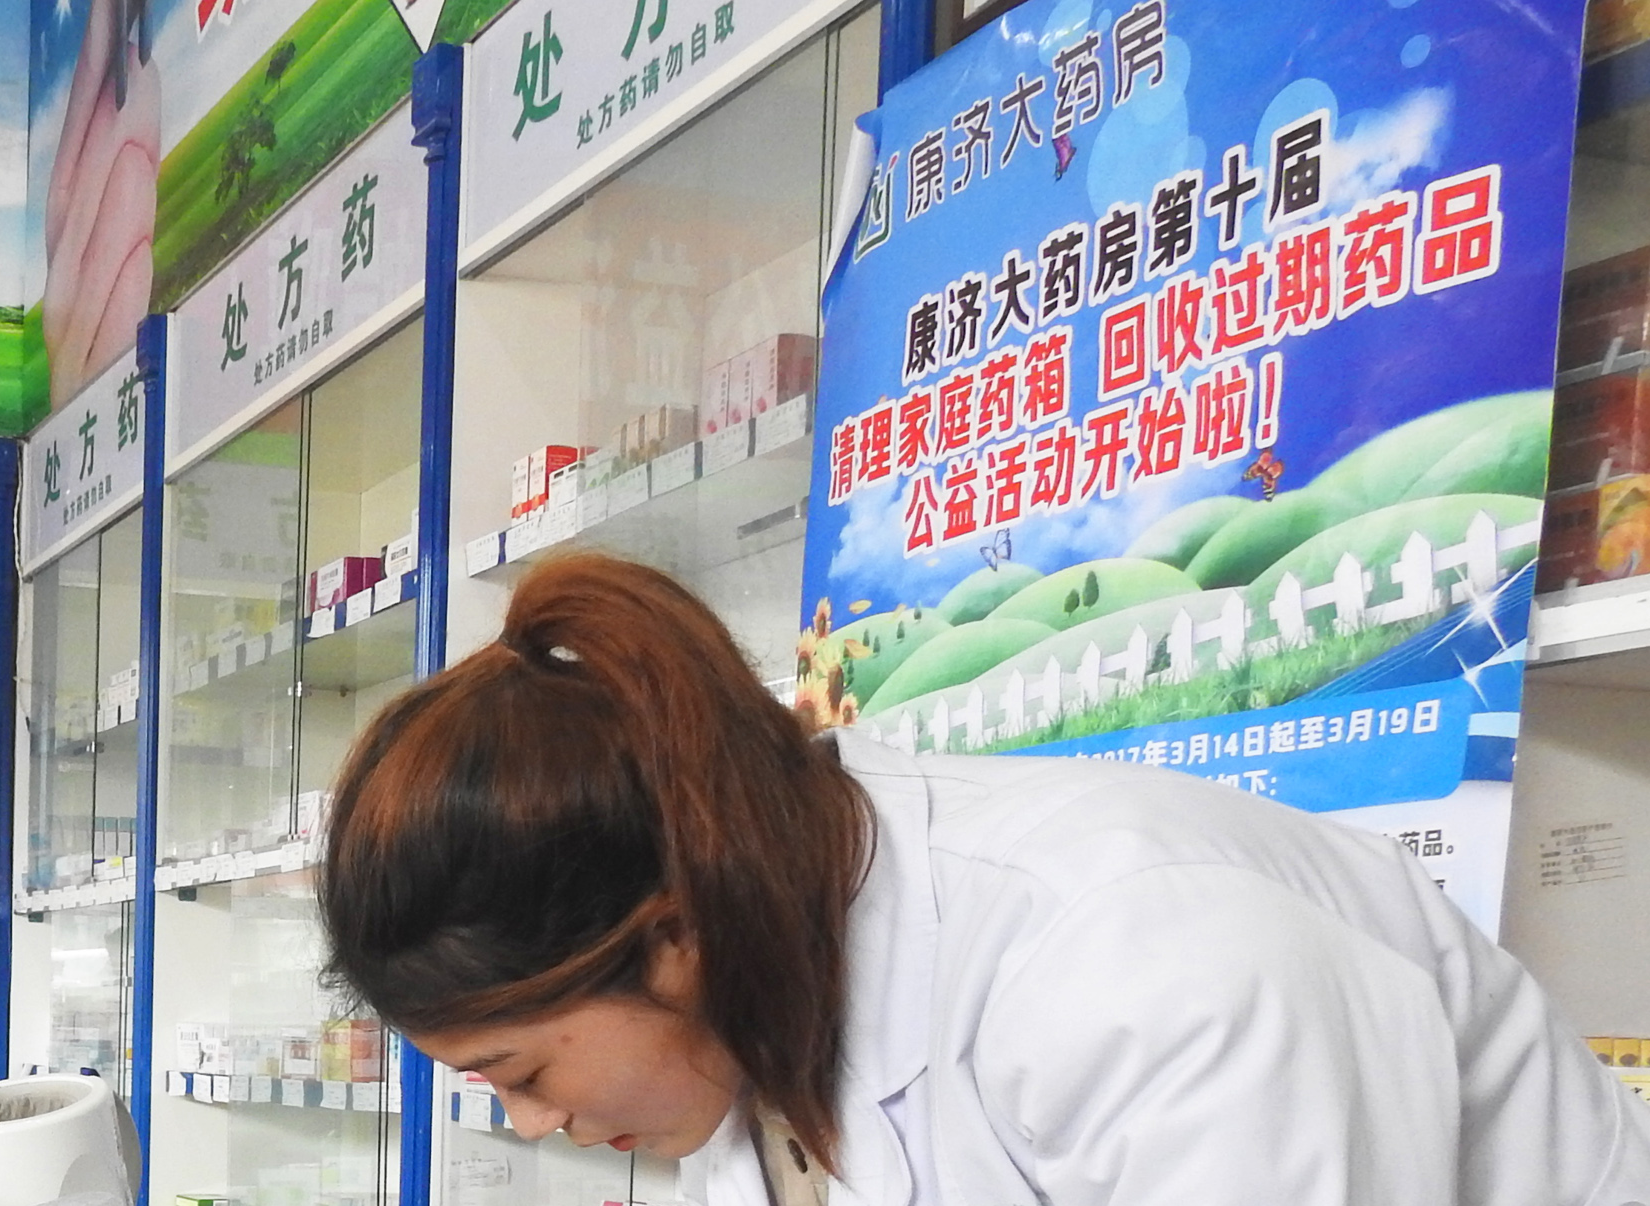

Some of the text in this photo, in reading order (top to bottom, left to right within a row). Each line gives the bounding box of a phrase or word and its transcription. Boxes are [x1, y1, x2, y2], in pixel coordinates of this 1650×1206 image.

[576, 1, 736, 150] 处方药请勿自取
[906, 1, 1166, 223] 康济大药房
[220, 173, 380, 372] 处方药
[828, 165, 1503, 505] 清理家庭药箱 回收过期药品
[903, 112, 1327, 381] 康济大药房第十届
[43, 365, 147, 508] 处方药
[253, 309, 334, 387] 处方药请勿自取
[903, 353, 1286, 557] 公益活动开始啦!
